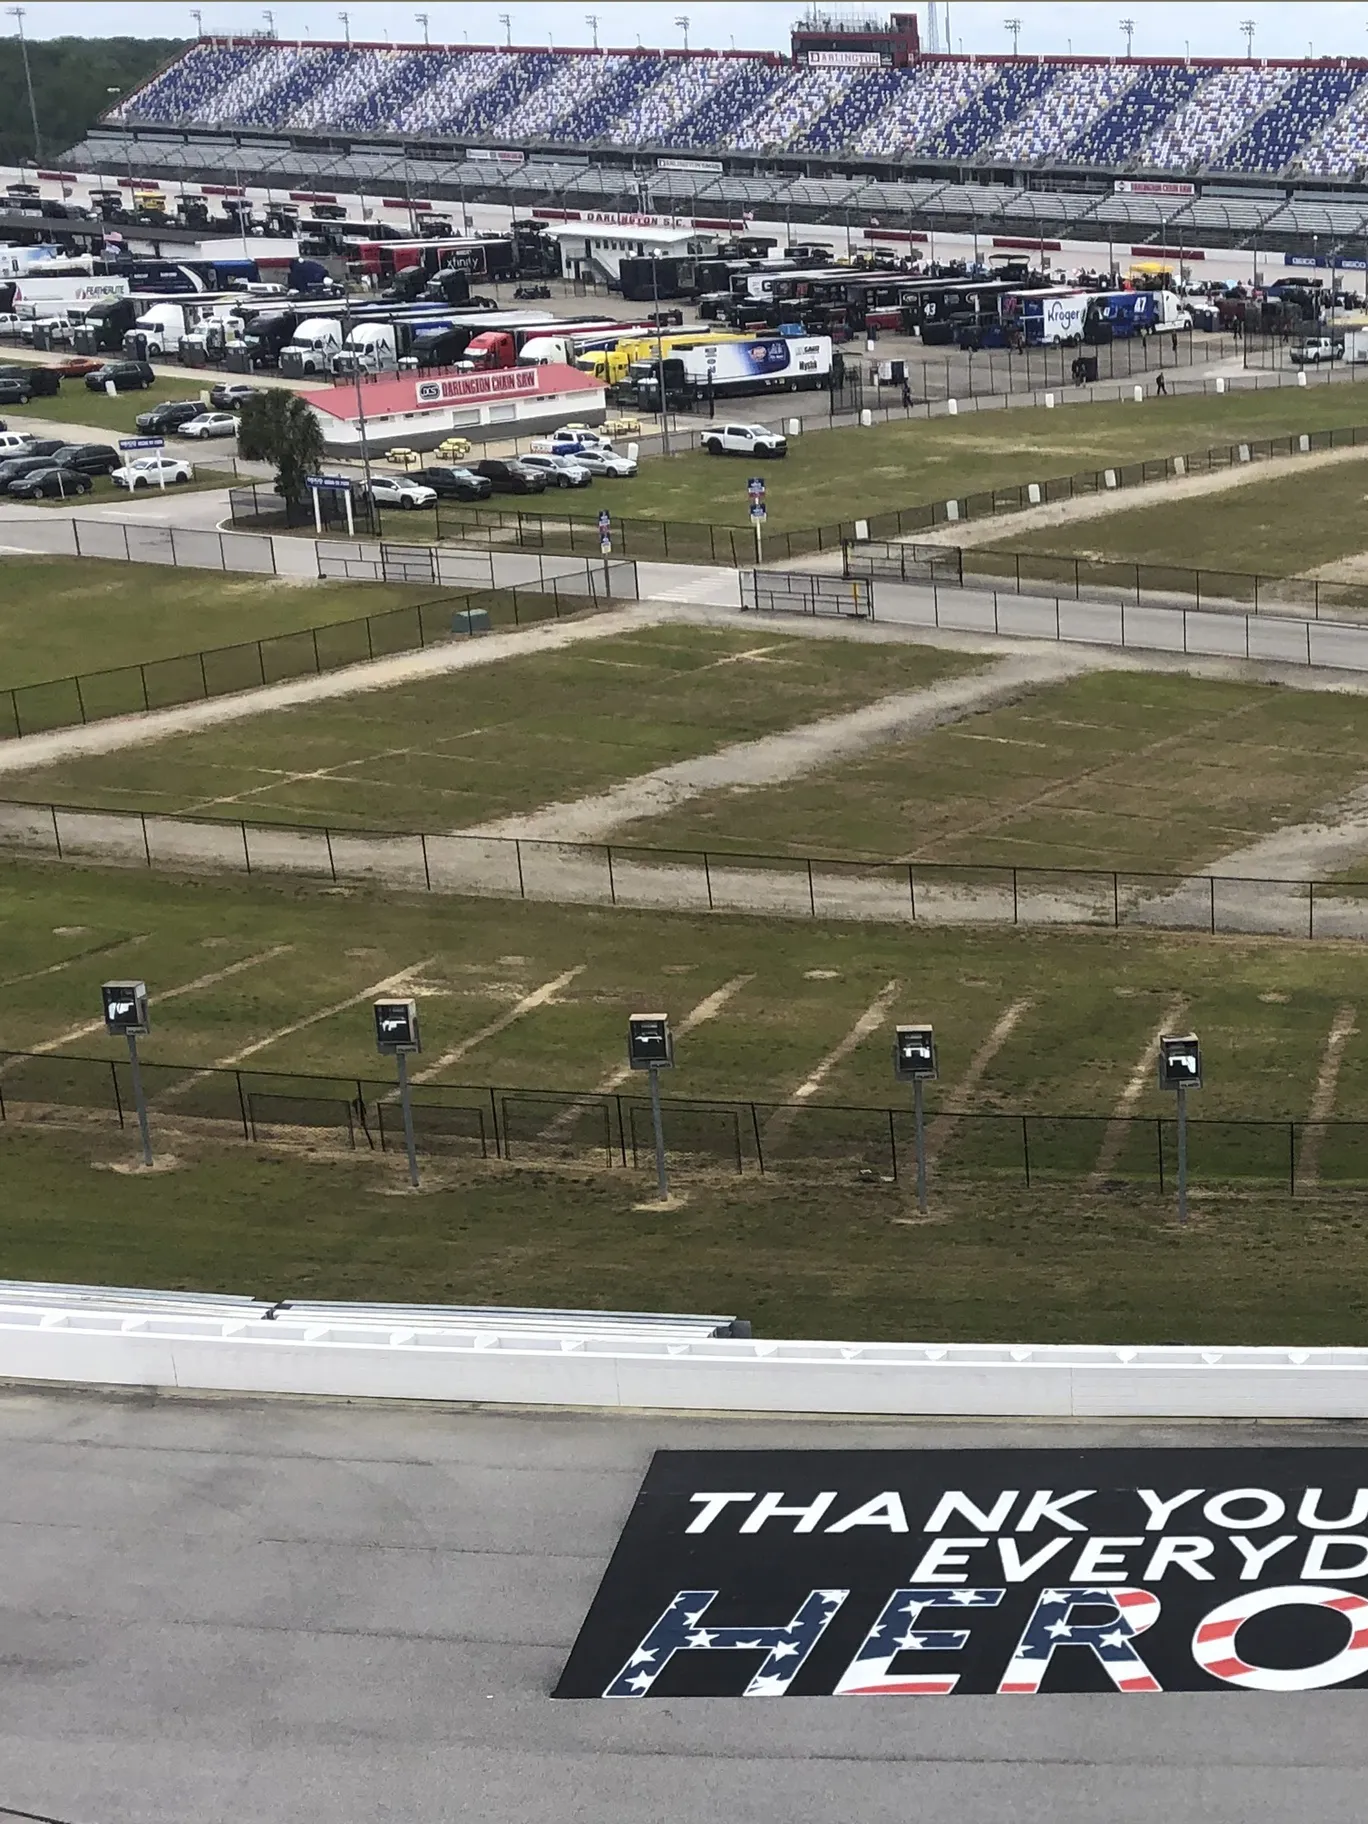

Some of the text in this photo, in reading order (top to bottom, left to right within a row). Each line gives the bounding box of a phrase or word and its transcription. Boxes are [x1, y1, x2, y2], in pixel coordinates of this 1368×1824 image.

[810, 52, 880, 62] DARLINGTON
[587, 213, 658, 225] DARLNGTON
[924, 303, 936, 316] 43
[1134, 296, 1147, 312] 47
[1048, 301, 1080, 330] Kroger
[441, 377, 491, 397] DARLINGTON
[516, 371, 535, 387] SAW
[684, 1489, 1097, 1534] THANK
